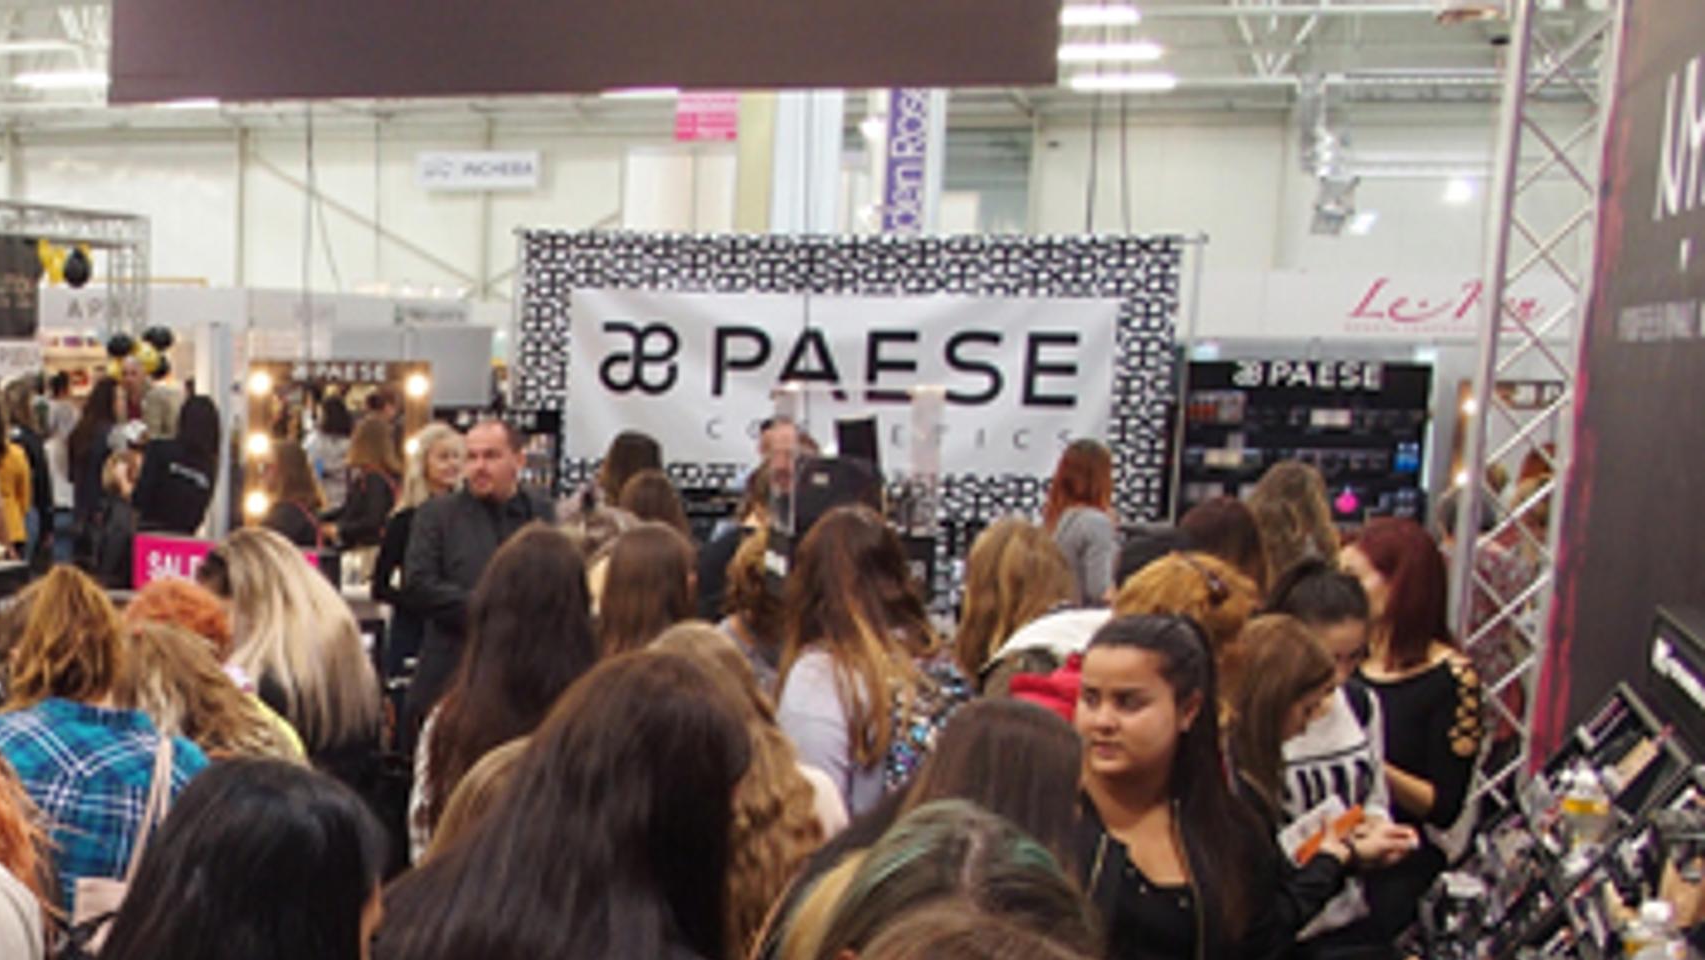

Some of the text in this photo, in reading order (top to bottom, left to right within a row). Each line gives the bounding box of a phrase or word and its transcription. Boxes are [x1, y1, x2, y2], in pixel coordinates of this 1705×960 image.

[315, 364, 387, 384] PAESE
[711, 325, 1080, 408] PAESE
[1268, 362, 1383, 392] PAESE
